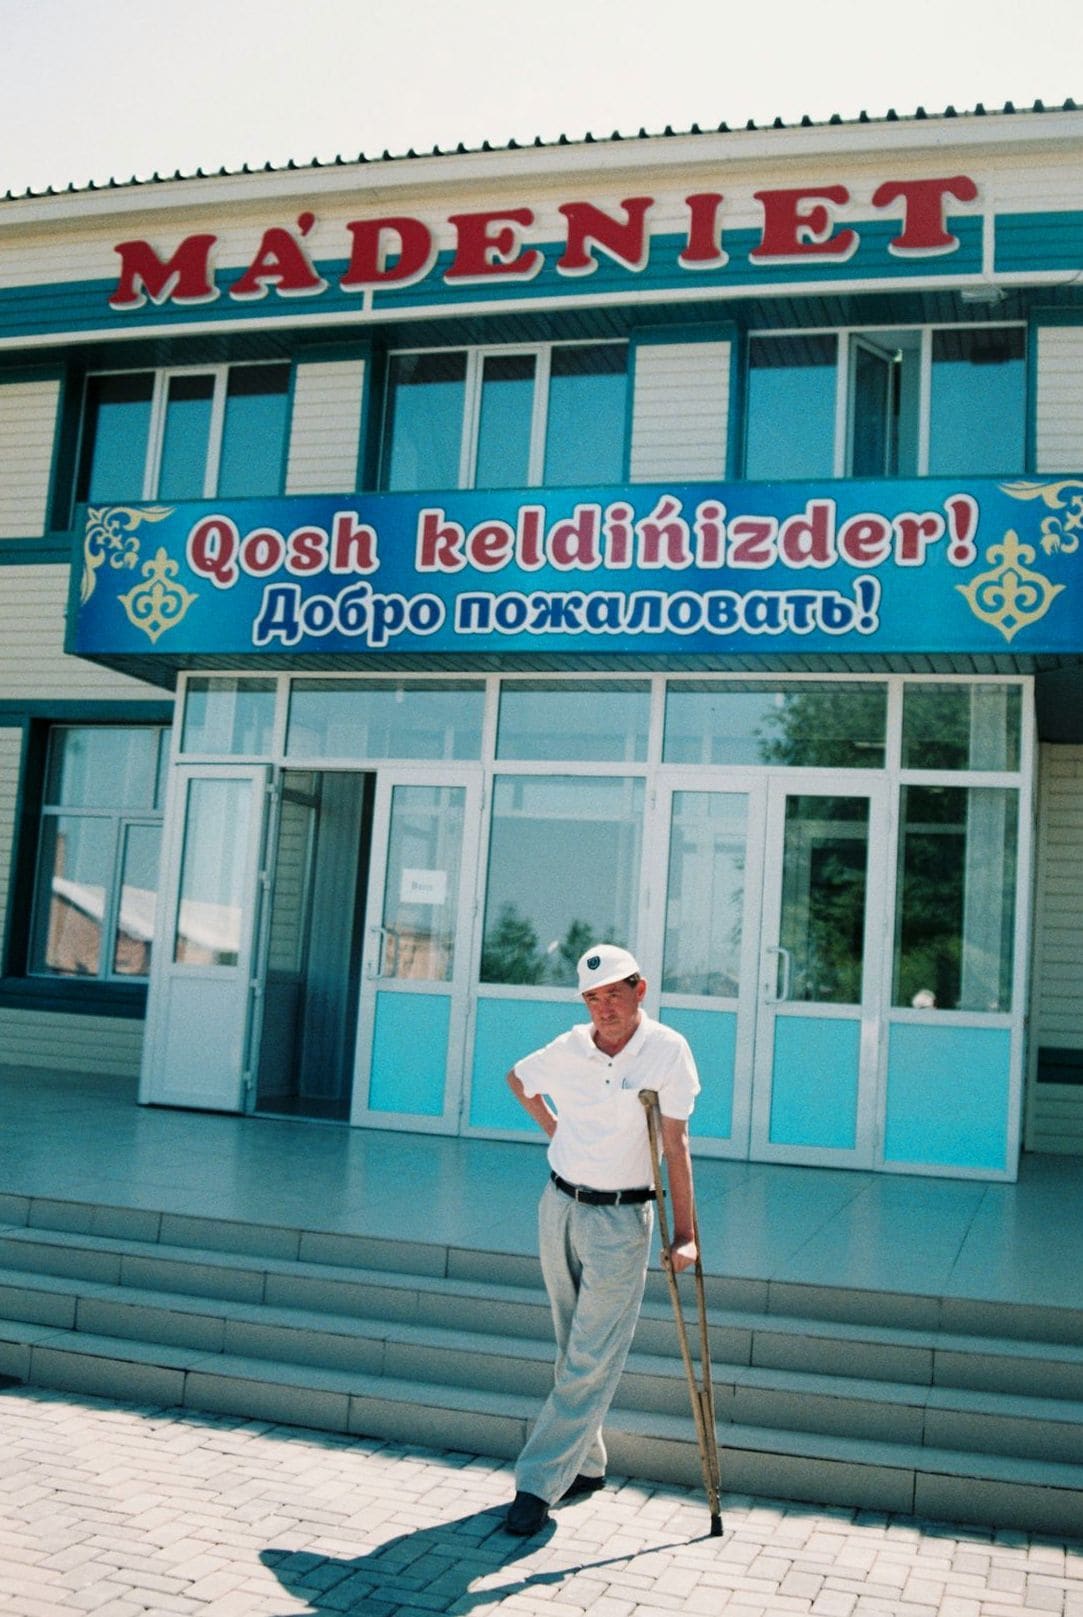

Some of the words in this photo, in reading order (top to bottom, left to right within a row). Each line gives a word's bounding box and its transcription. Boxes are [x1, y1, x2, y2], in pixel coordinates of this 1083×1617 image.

[187, 510, 379, 588] Qosh
[415, 494, 979, 571] keldińizder!
[252, 581, 446, 648] Добро
[454, 574, 881, 636] пожаловать!
